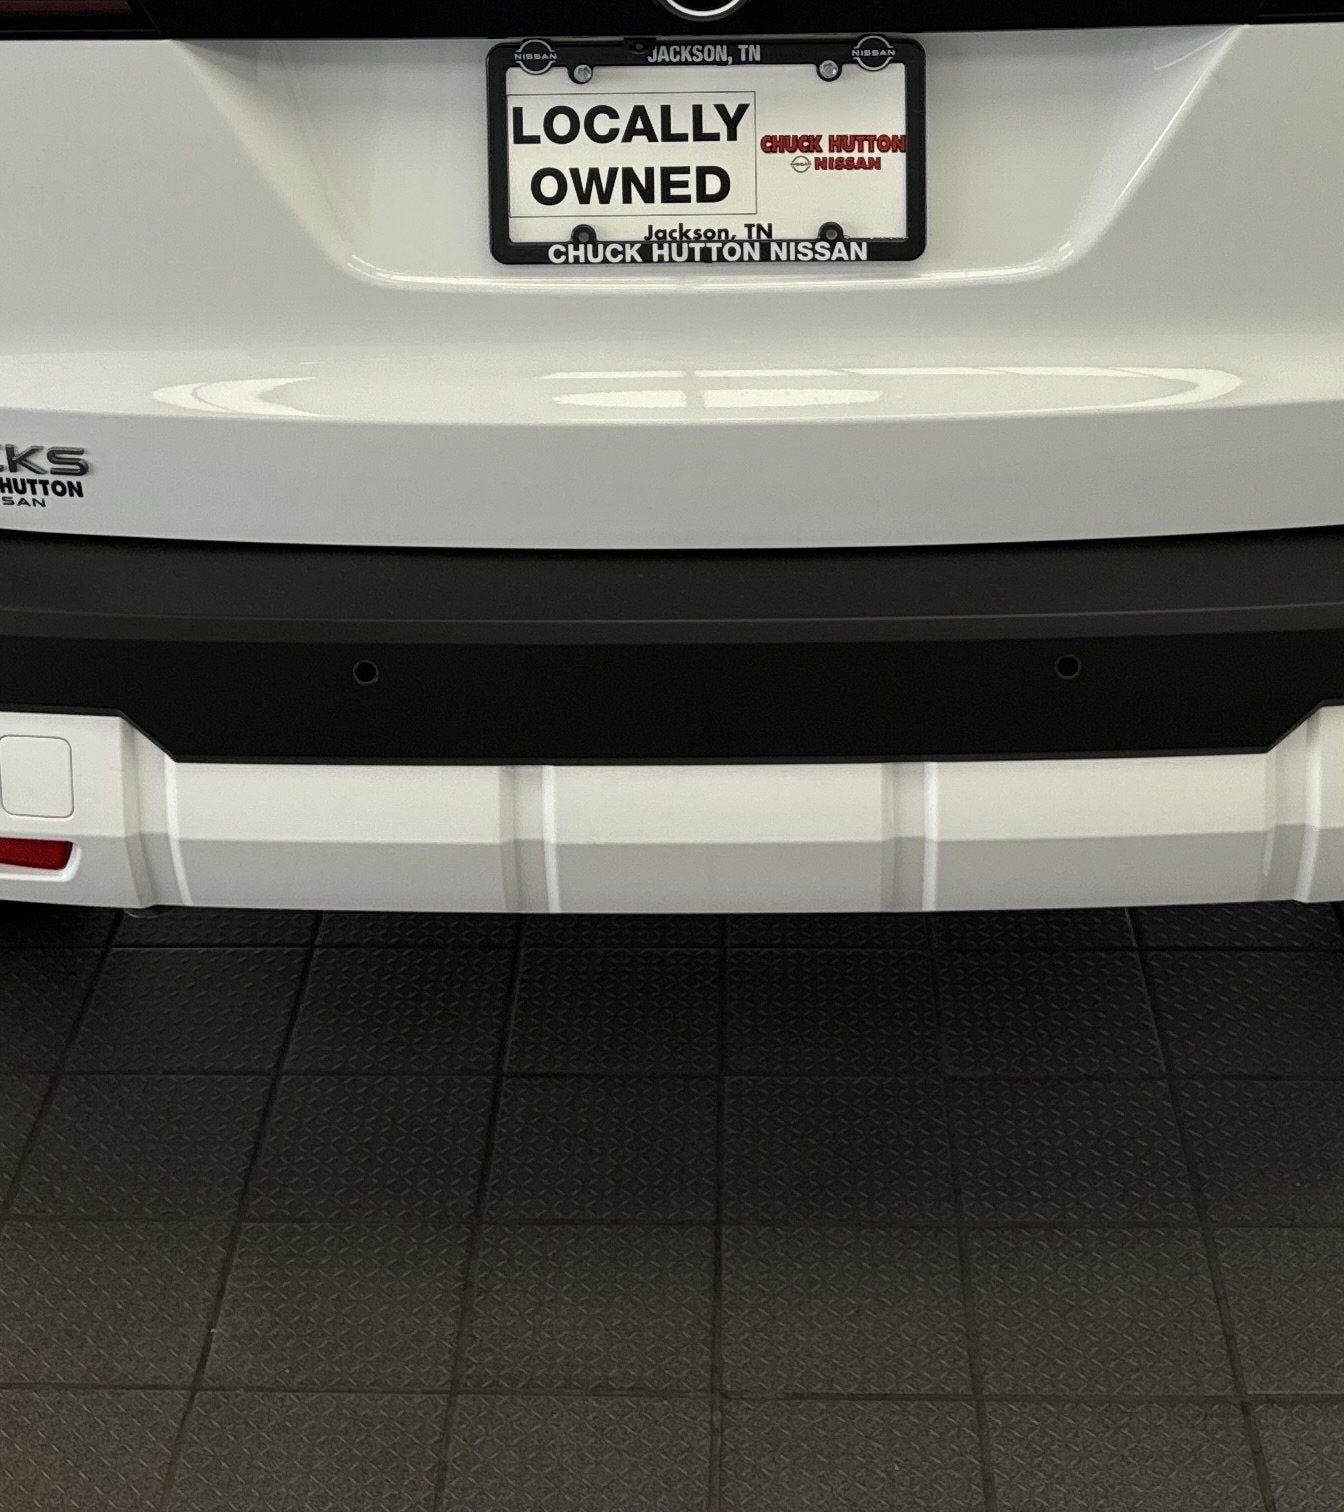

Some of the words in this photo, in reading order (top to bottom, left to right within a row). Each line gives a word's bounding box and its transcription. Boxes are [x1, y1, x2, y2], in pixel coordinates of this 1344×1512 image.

[647, 44, 733, 65] JACKSON,
[738, 44, 761, 61] TN
[851, 49, 896, 57] NISSAN
[512, 102, 750, 145] LOCALLY
[760, 134, 823, 153] CHUCK
[828, 134, 907, 153] HUTTON
[814, 156, 881, 170] NISSAN
[530, 166, 731, 206] OWNED
[644, 222, 736, 241] Jackson,
[743, 223, 773, 240] TN
[548, 243, 643, 264] CHUCK
[652, 242, 760, 263] HUTTON
[770, 241, 868, 261] NISSAN
[0, 477, 84, 498] HUTTON
